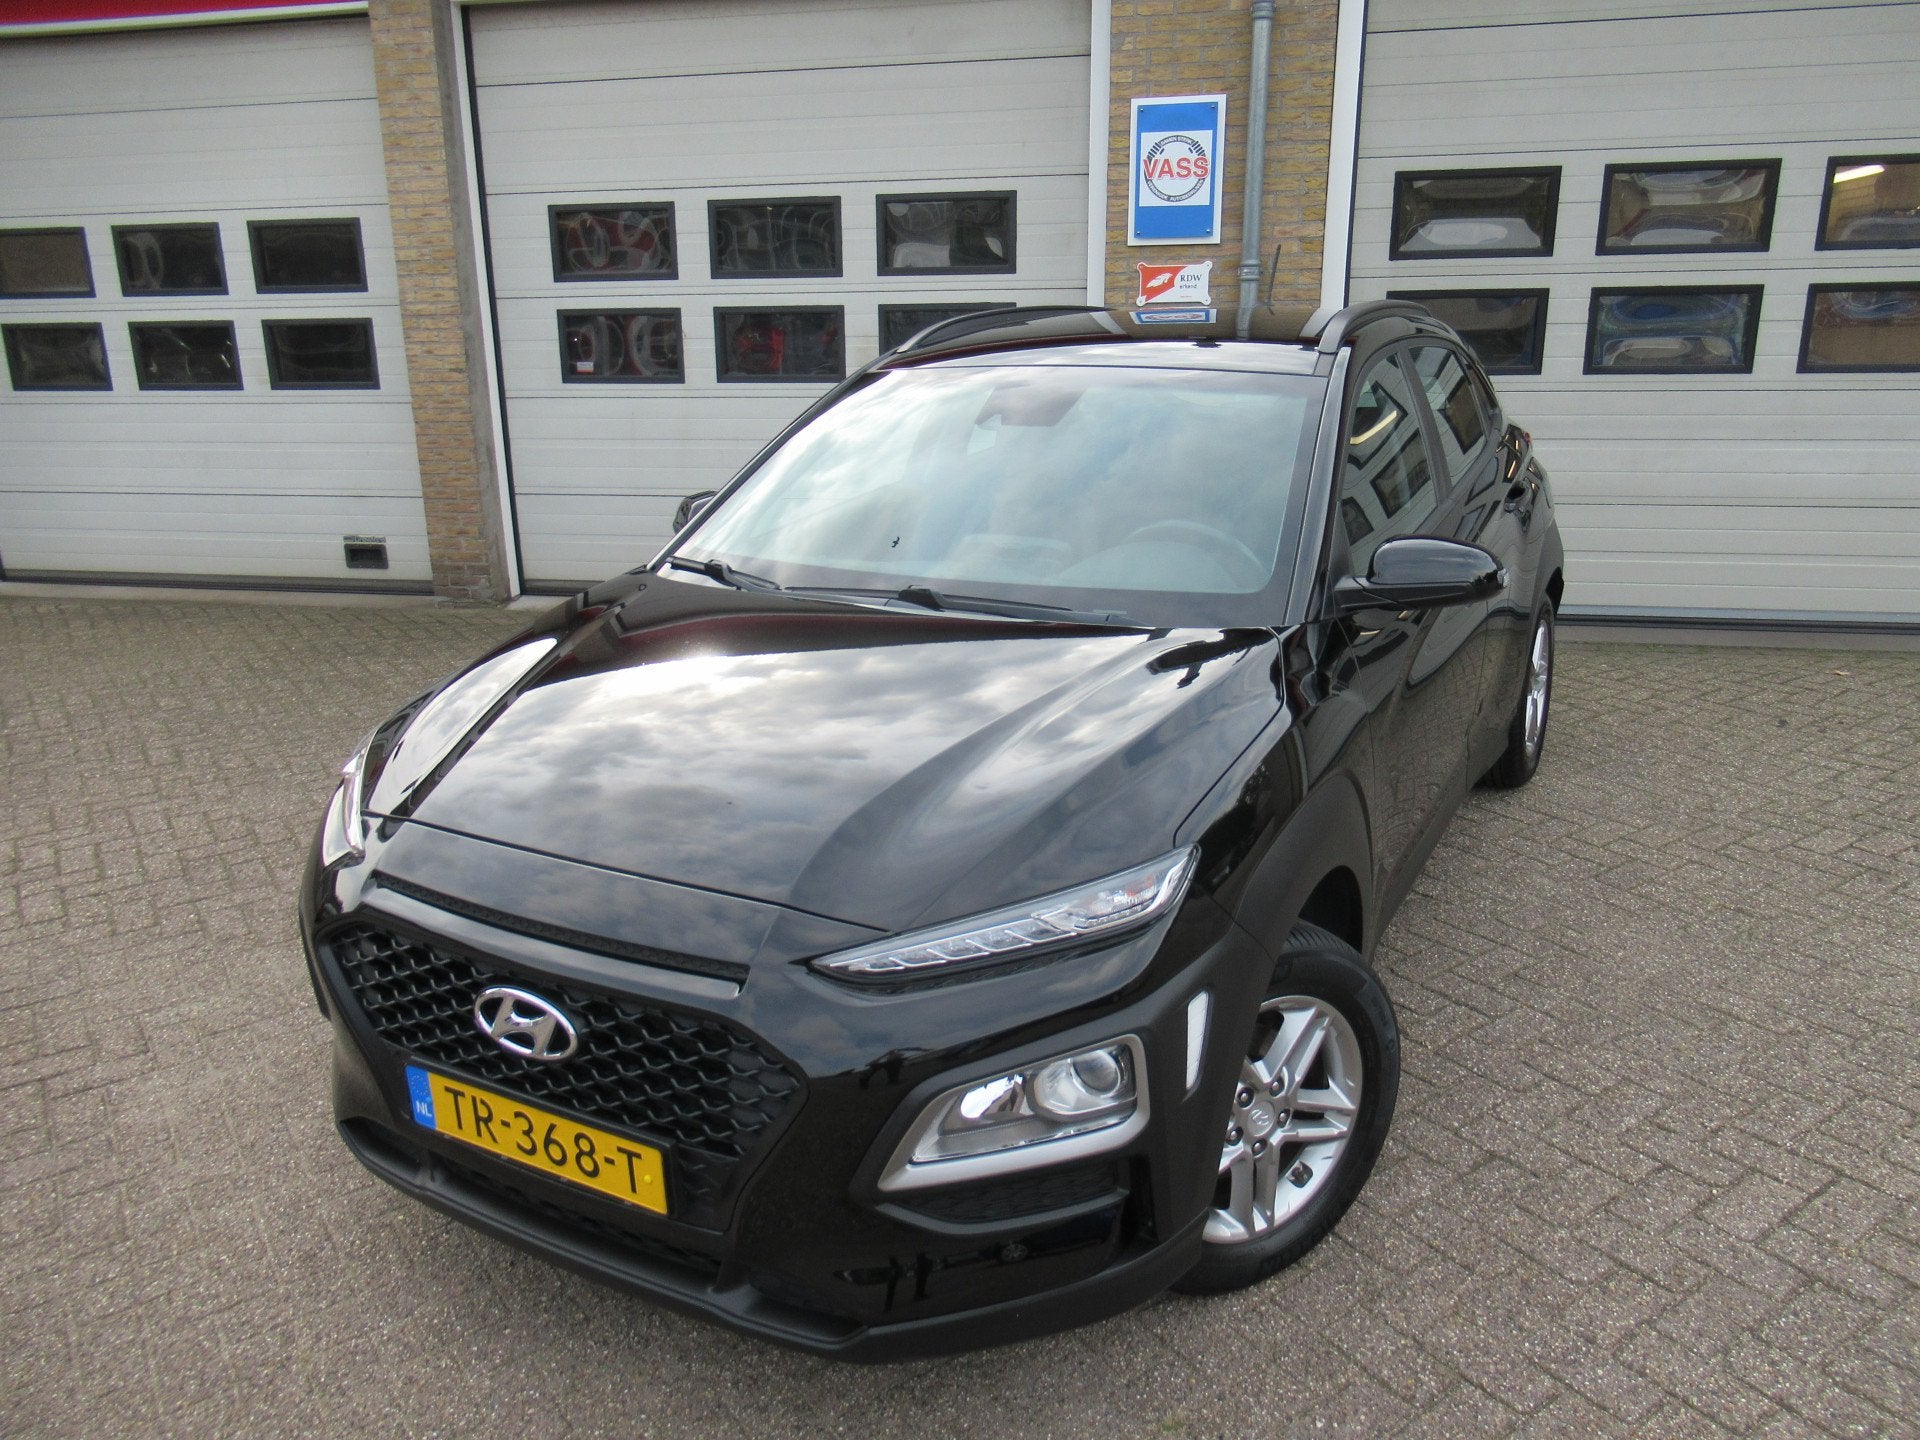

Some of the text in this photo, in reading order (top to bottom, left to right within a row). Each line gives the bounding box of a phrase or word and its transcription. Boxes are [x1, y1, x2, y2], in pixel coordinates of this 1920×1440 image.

[1143, 157, 1209, 179] VASS
[1180, 274, 1202, 282] RDW
[416, 1101, 432, 1117] NL
[444, 1086, 642, 1194] TR-368-T
